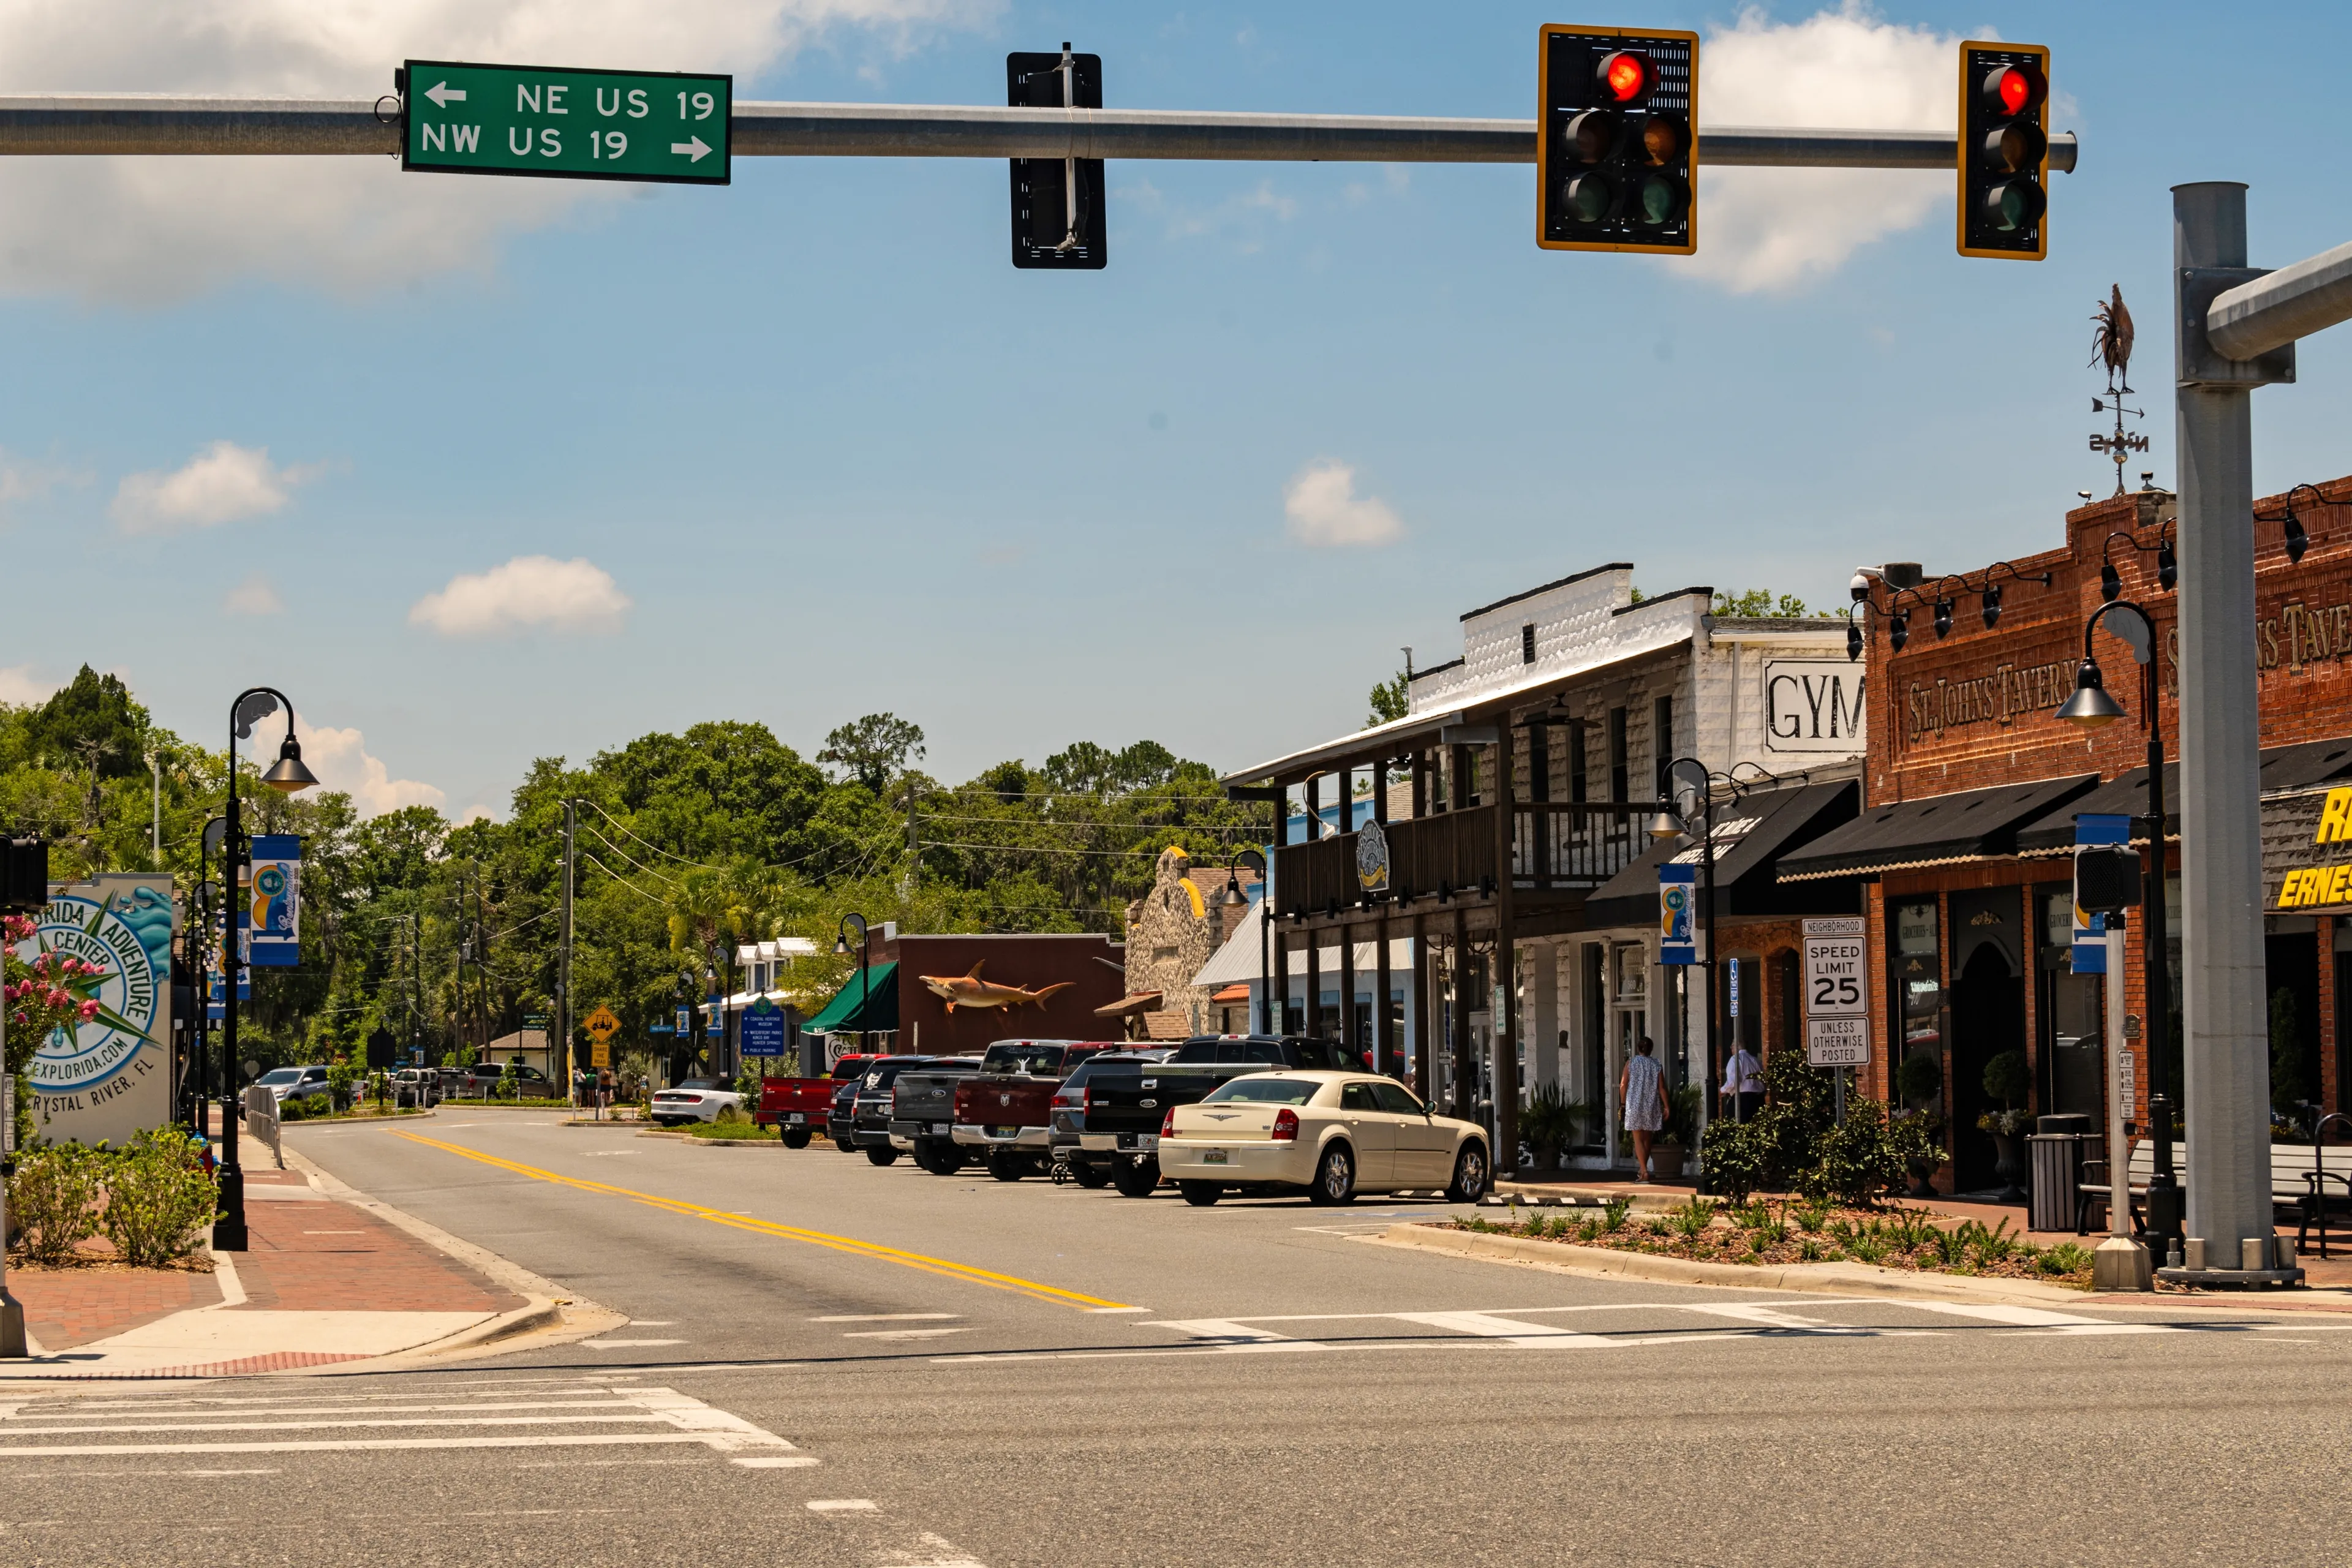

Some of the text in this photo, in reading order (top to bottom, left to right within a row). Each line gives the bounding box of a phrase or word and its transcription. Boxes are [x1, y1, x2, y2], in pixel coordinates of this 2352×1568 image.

[518, 84, 715, 120] NE US 19
[422, 123, 628, 160] NW US 19
[1997, 658, 2078, 728] TAVERN
[278, 865, 294, 930] Centennial
[1807, 921, 1860, 933] NEIGHBORHOOD
[32, 902, 151, 1020] ORIDA ADVENTURE
[55, 931, 111, 966] CENTER
[1810, 946, 1860, 959] SPEED
[1816, 962, 1854, 974] LIMIT
[1814, 978, 1860, 1005] 25
[1814, 1035, 1863, 1047] OTHERWISE
[1820, 1022, 1855, 1034] UNLESS
[1822, 1049, 1855, 1061] POSTED
[31, 1059, 154, 1112] RYSTAL RIVER, FL
